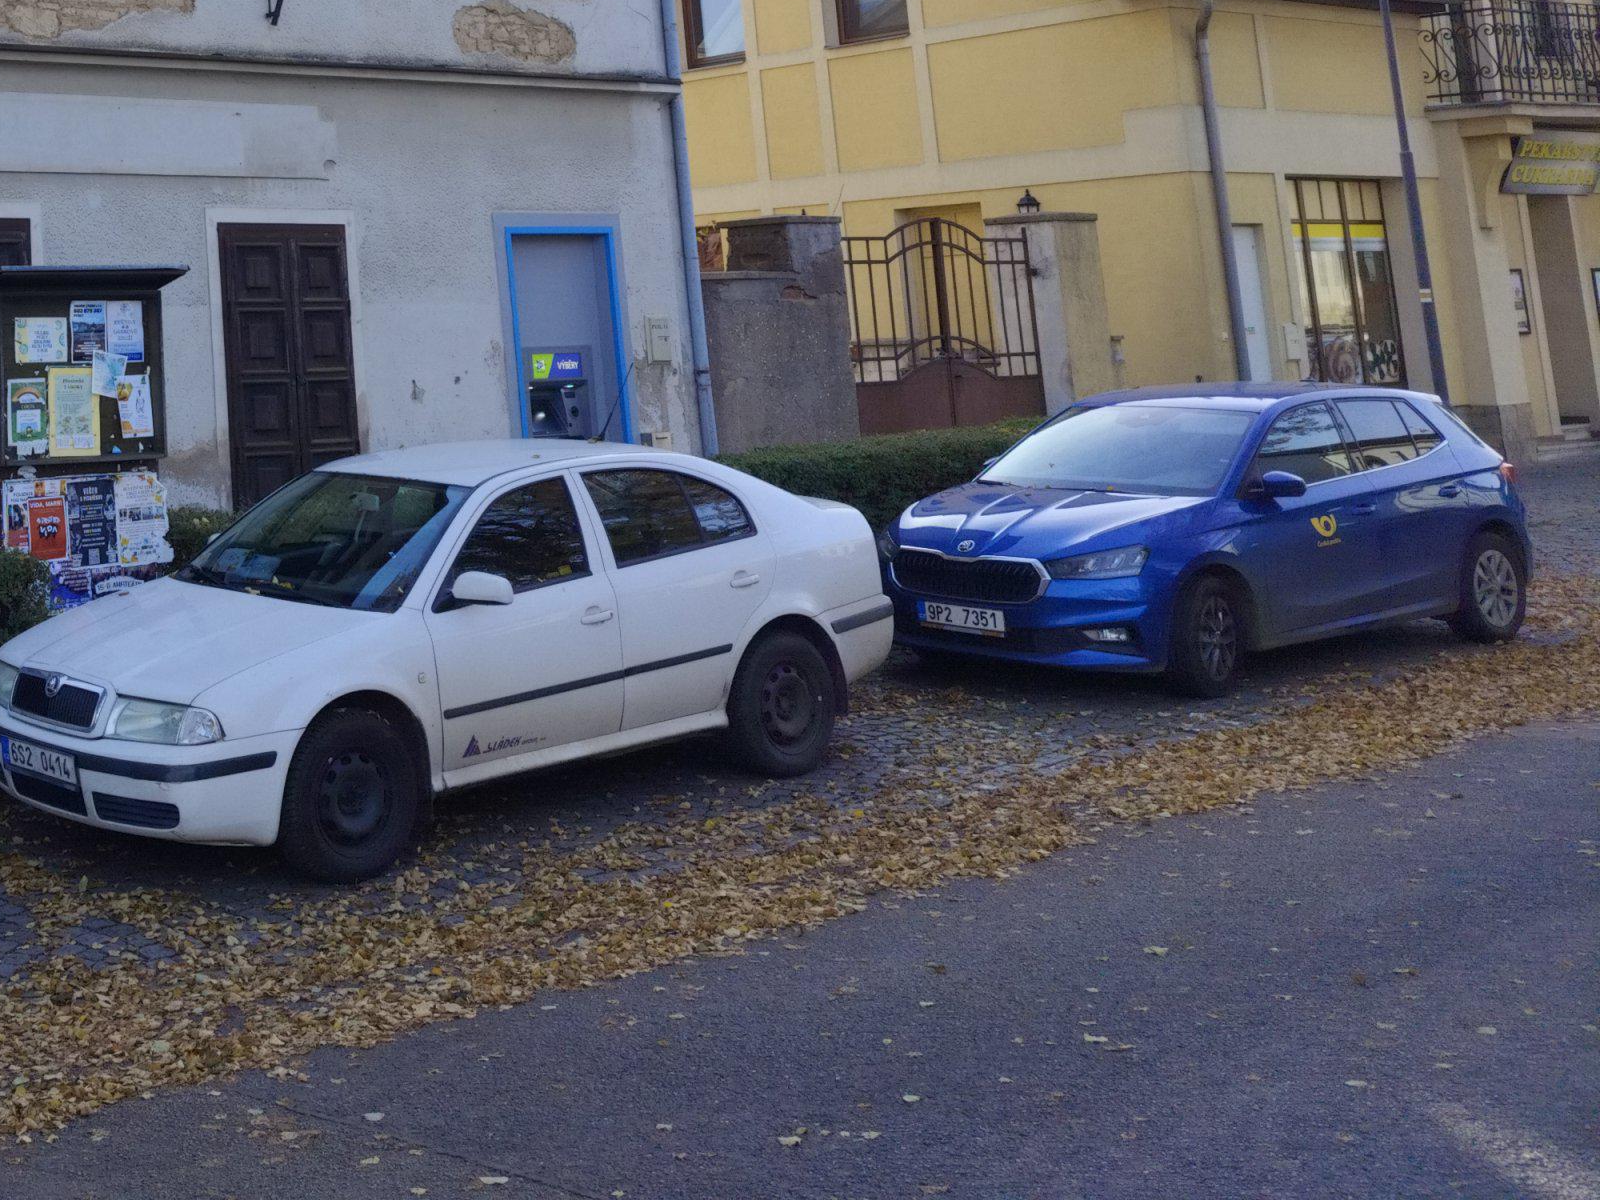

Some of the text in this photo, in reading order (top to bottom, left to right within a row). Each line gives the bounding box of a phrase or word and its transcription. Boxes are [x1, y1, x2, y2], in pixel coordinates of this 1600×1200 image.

[927, 604, 997, 629] 9P2 7351
[10, 742, 71, 779] 6S2 0414
